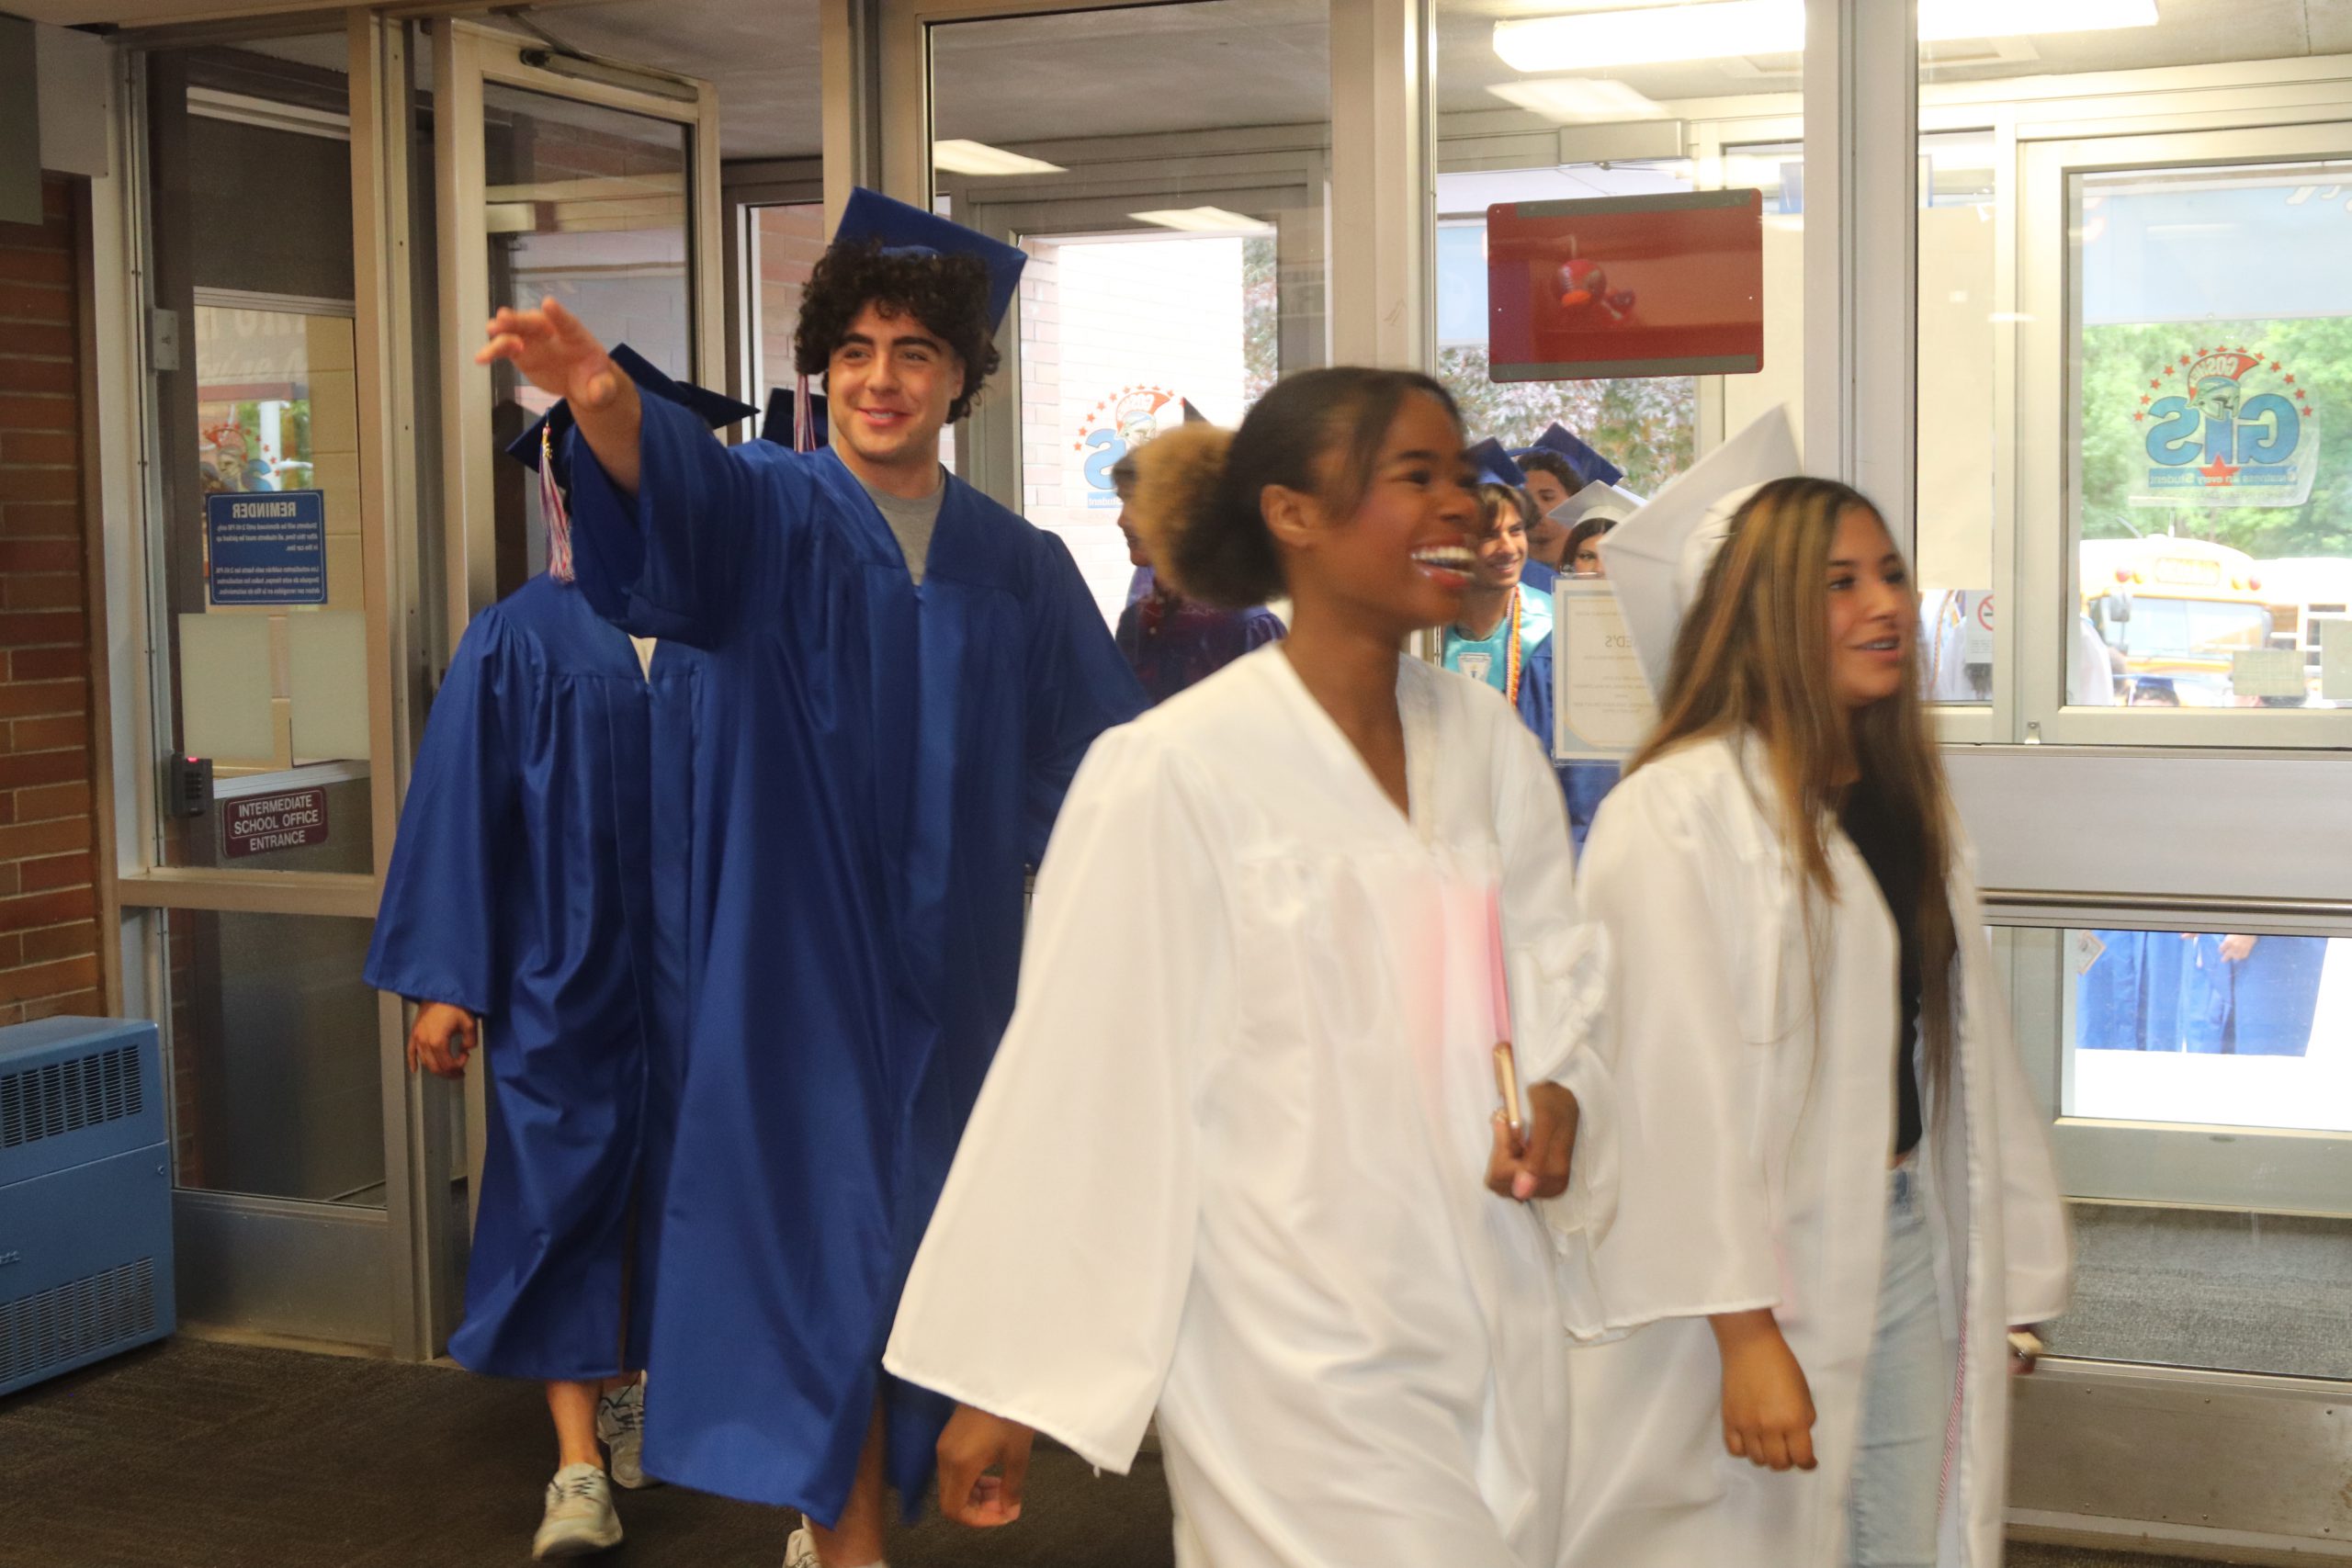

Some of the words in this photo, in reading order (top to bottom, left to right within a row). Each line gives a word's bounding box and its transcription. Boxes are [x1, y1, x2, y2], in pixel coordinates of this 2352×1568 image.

[239, 795, 312, 818] INTERMEDIATE
[234, 817, 279, 835] SCHOOL
[282, 809, 319, 827] OFFICE
[250, 830, 306, 852] ENTRANCE
